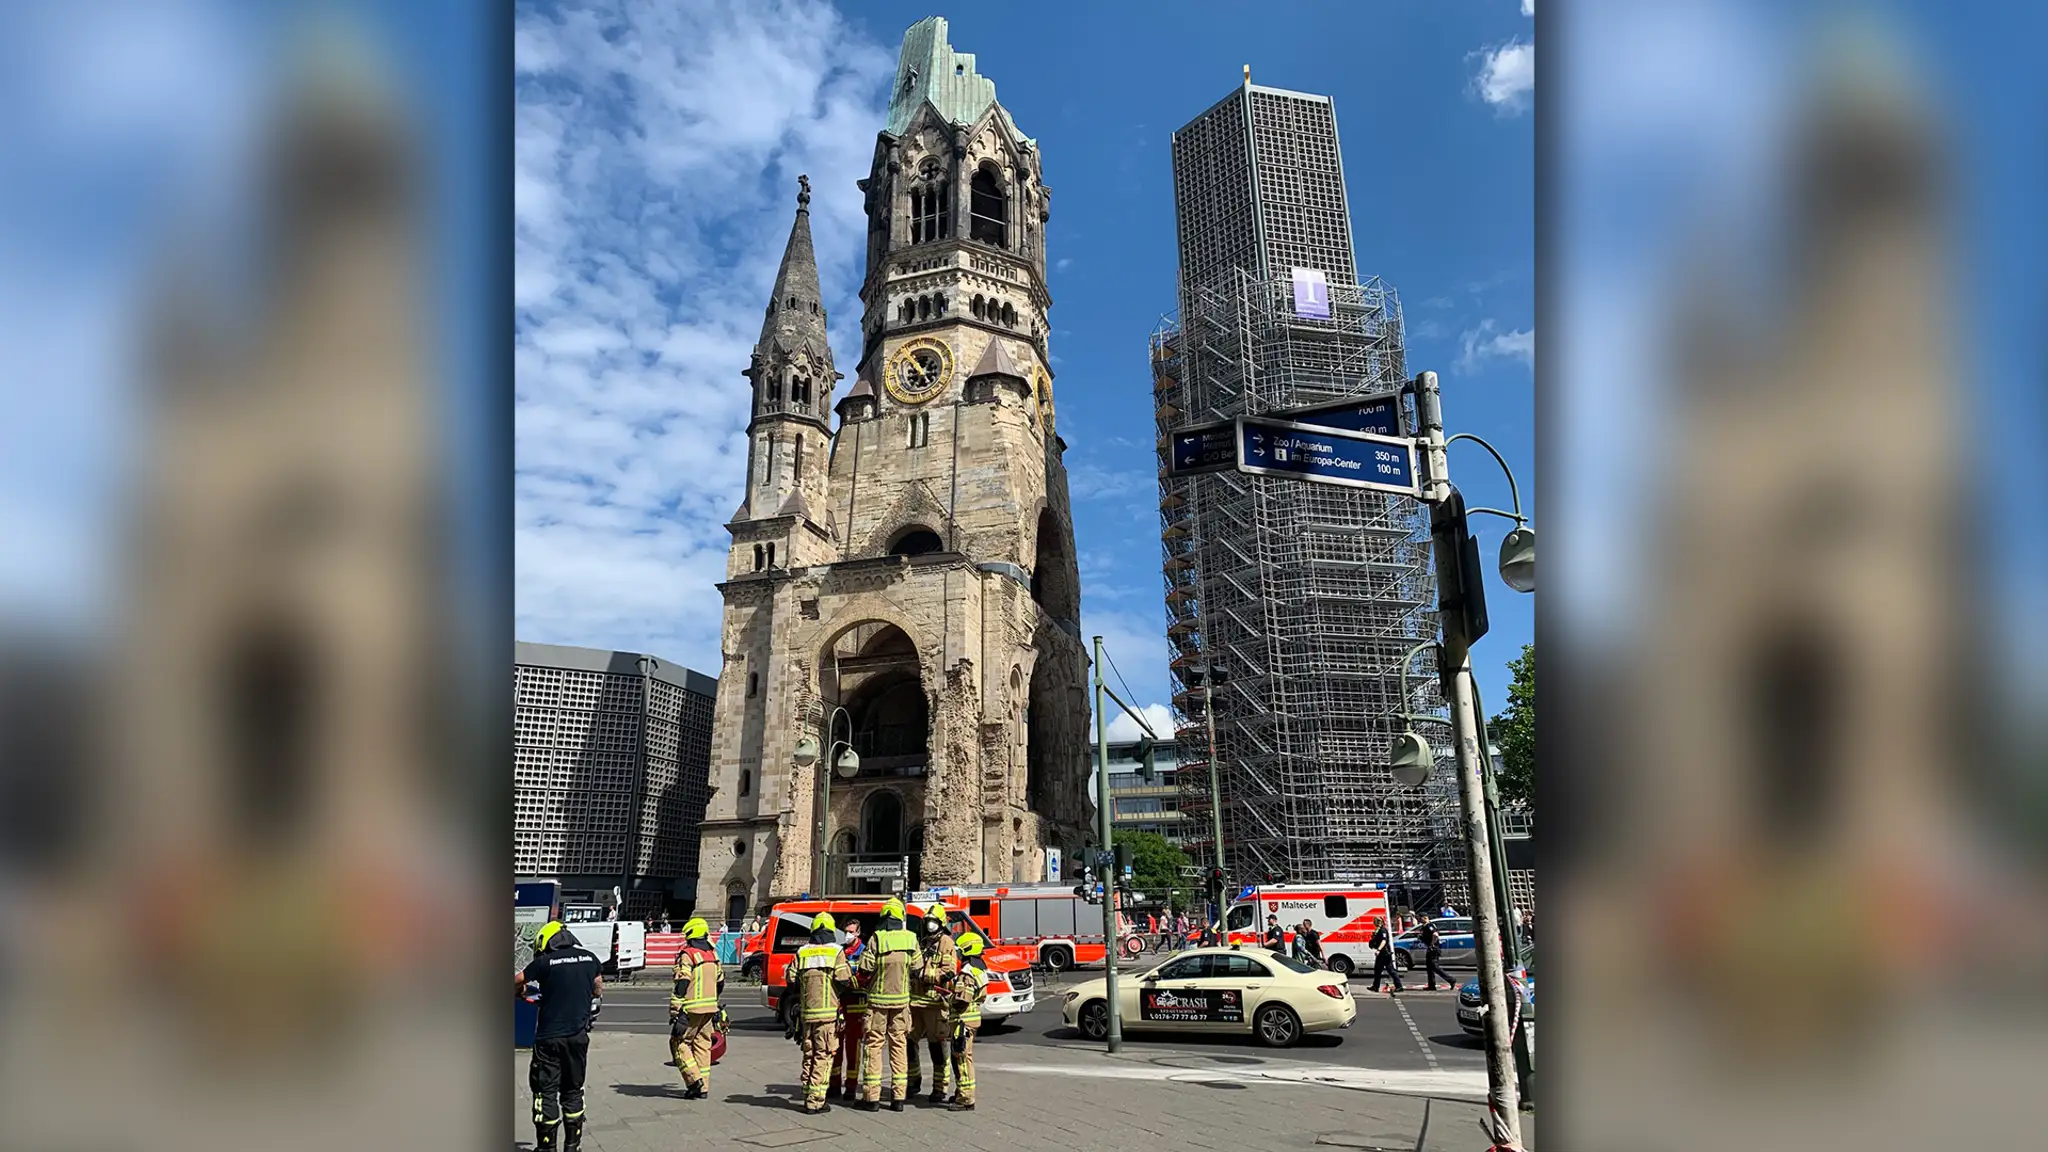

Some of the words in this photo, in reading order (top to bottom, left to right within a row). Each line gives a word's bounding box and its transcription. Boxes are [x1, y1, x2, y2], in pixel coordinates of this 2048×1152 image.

[1273, 436, 1289, 447] Zoo
[1295, 439, 1333, 454] Aquarium
[1291, 451, 1301, 461] im
[1303, 453, 1361, 470] Europa-Center
[1374, 450, 1390, 462] 350
[1391, 454, 1400, 463] m
[1377, 463, 1392, 474] 100
[1392, 467, 1401, 476] m
[850, 865, 899, 874] Kurfürstendamm
[1281, 901, 1317, 909] Malteser
[1175, 997, 1208, 1009] CRASH
